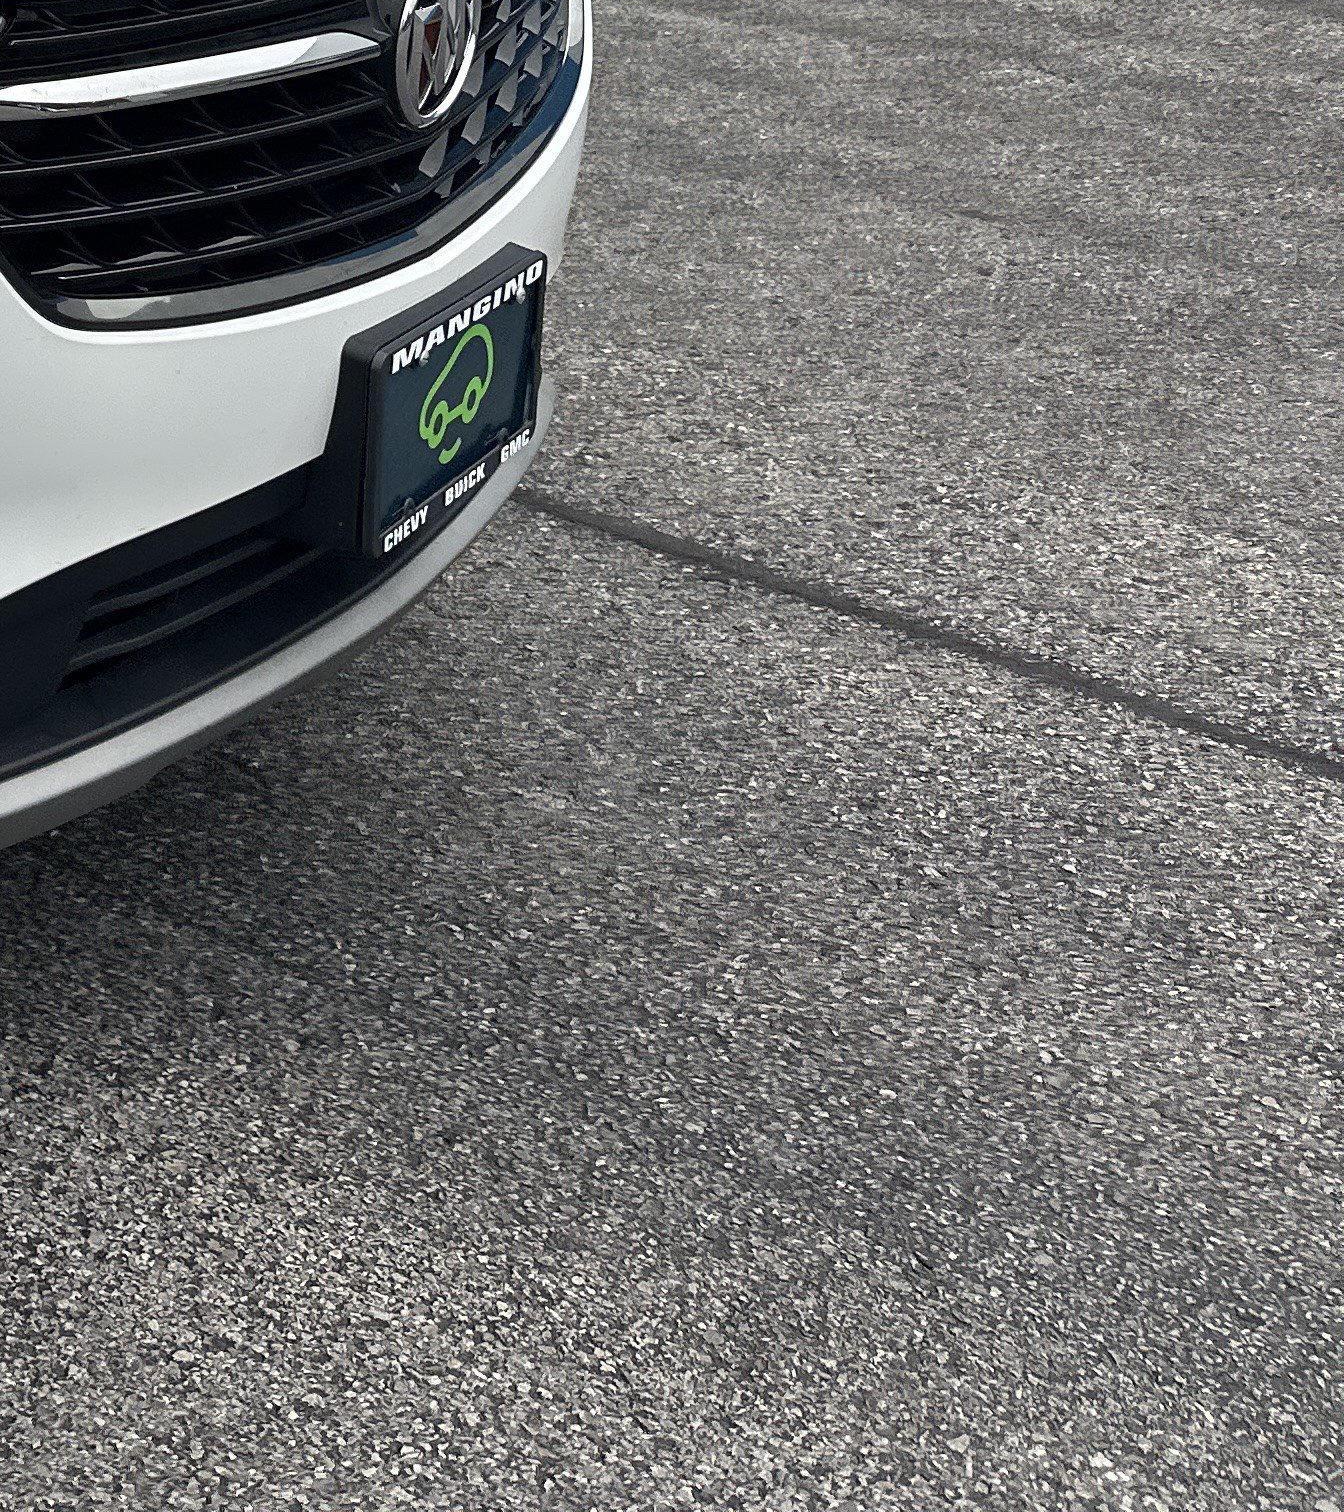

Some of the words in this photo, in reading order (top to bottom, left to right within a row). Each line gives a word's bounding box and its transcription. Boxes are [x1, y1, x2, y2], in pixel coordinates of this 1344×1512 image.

[391, 259, 543, 375] MANGINO
[383, 505, 428, 553] CHEVY
[444, 462, 485, 507] BUICK
[500, 428, 530, 463] GMC
